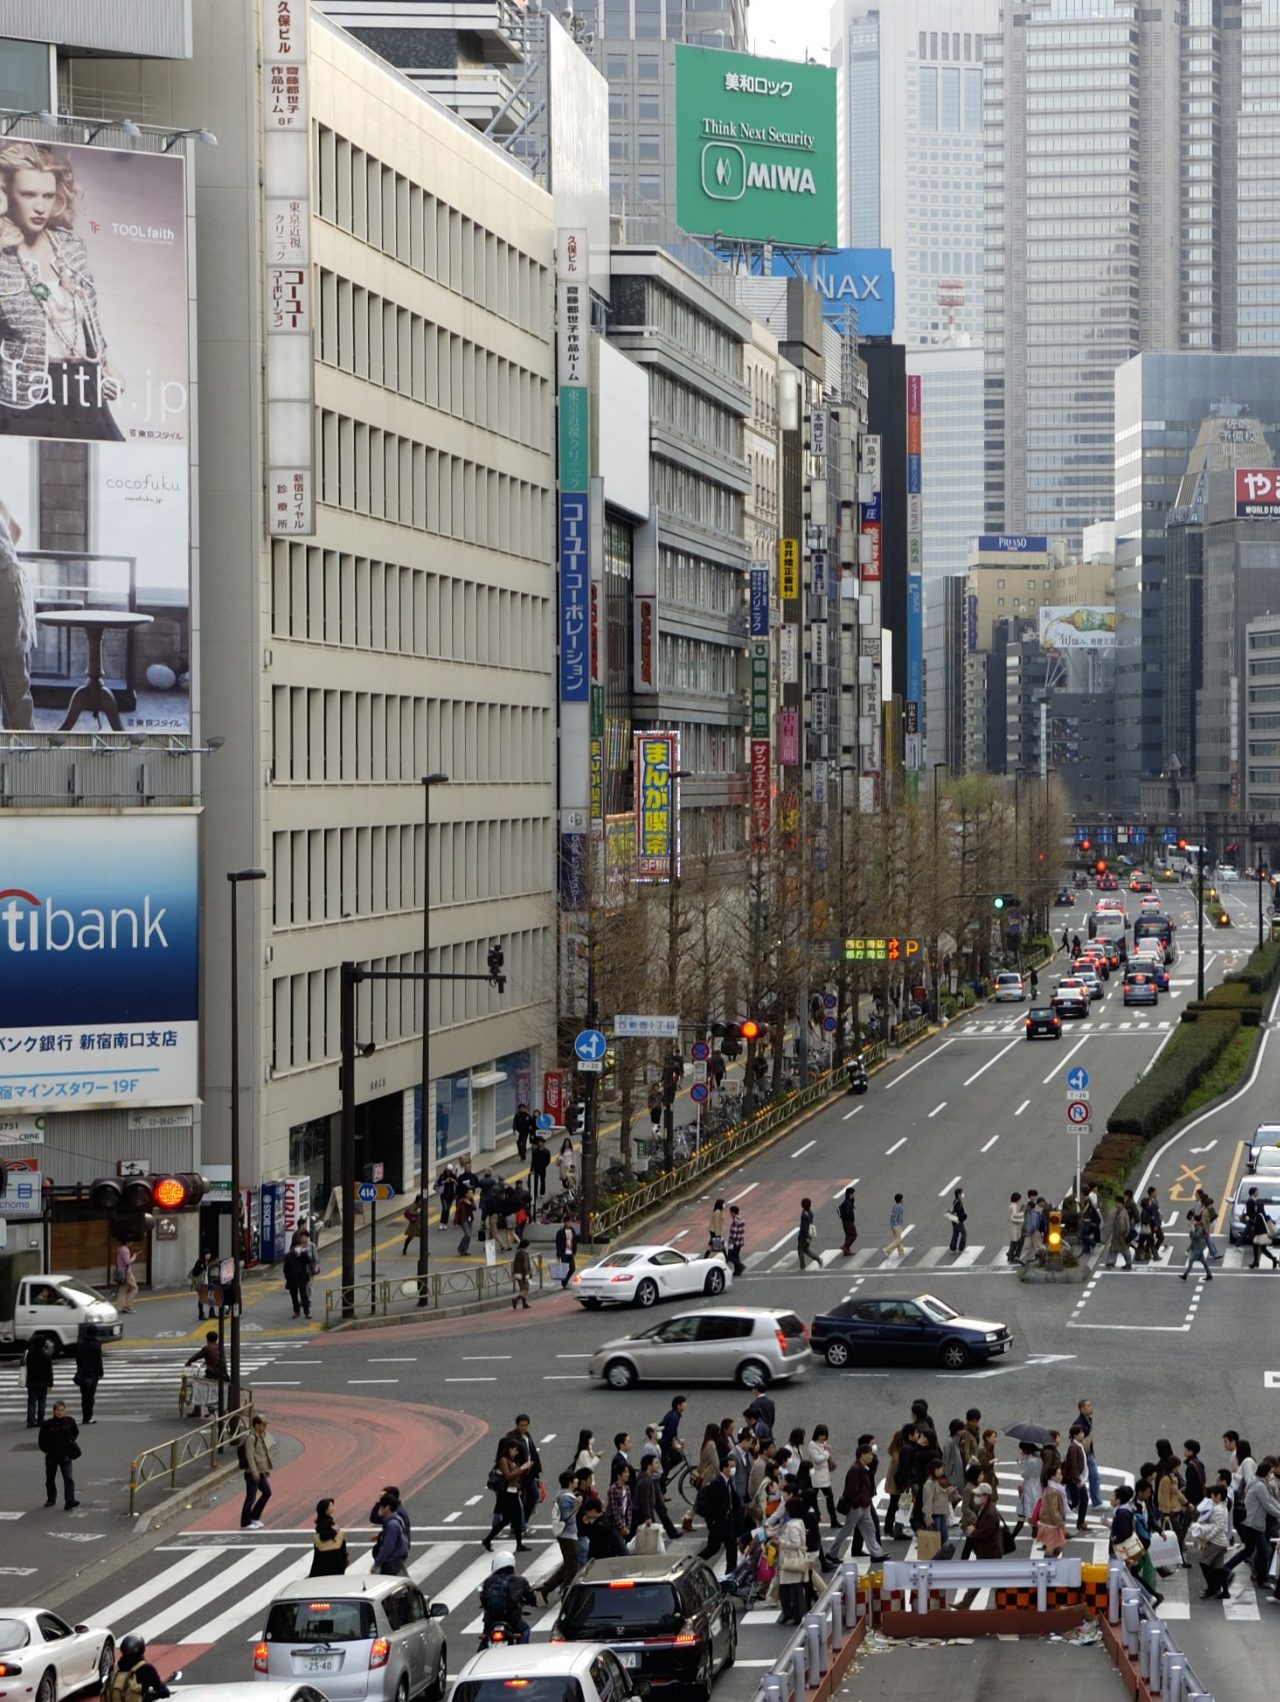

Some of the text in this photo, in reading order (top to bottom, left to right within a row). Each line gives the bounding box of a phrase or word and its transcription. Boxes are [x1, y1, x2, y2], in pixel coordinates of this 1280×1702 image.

[278, 1, 291, 53] 久保ビル
[726, 72, 792, 97] 美和ロック
[702, 118, 815, 148] Think Next Security
[747, 161, 817, 195] MIWA
[147, 227, 174, 241] faith
[284, 270, 304, 328] コーユー
[138, 429, 184, 441] 東京スタイル
[1246, 505, 1269, 514] WORLD
[563, 504, 586, 570] コーユー
[645, 741, 669, 855] まんが喫茶
[906, 940, 919, 957] P
[80, 1030, 178, 1050] 新宿南口支店
[0, 1079, 140, 1100] 宿マインズタワー 19F
[360, 1187, 376, 1197] 414
[263, 1203, 272, 1227] BOSS
[285, 1183, 296, 1232] KIRIN
